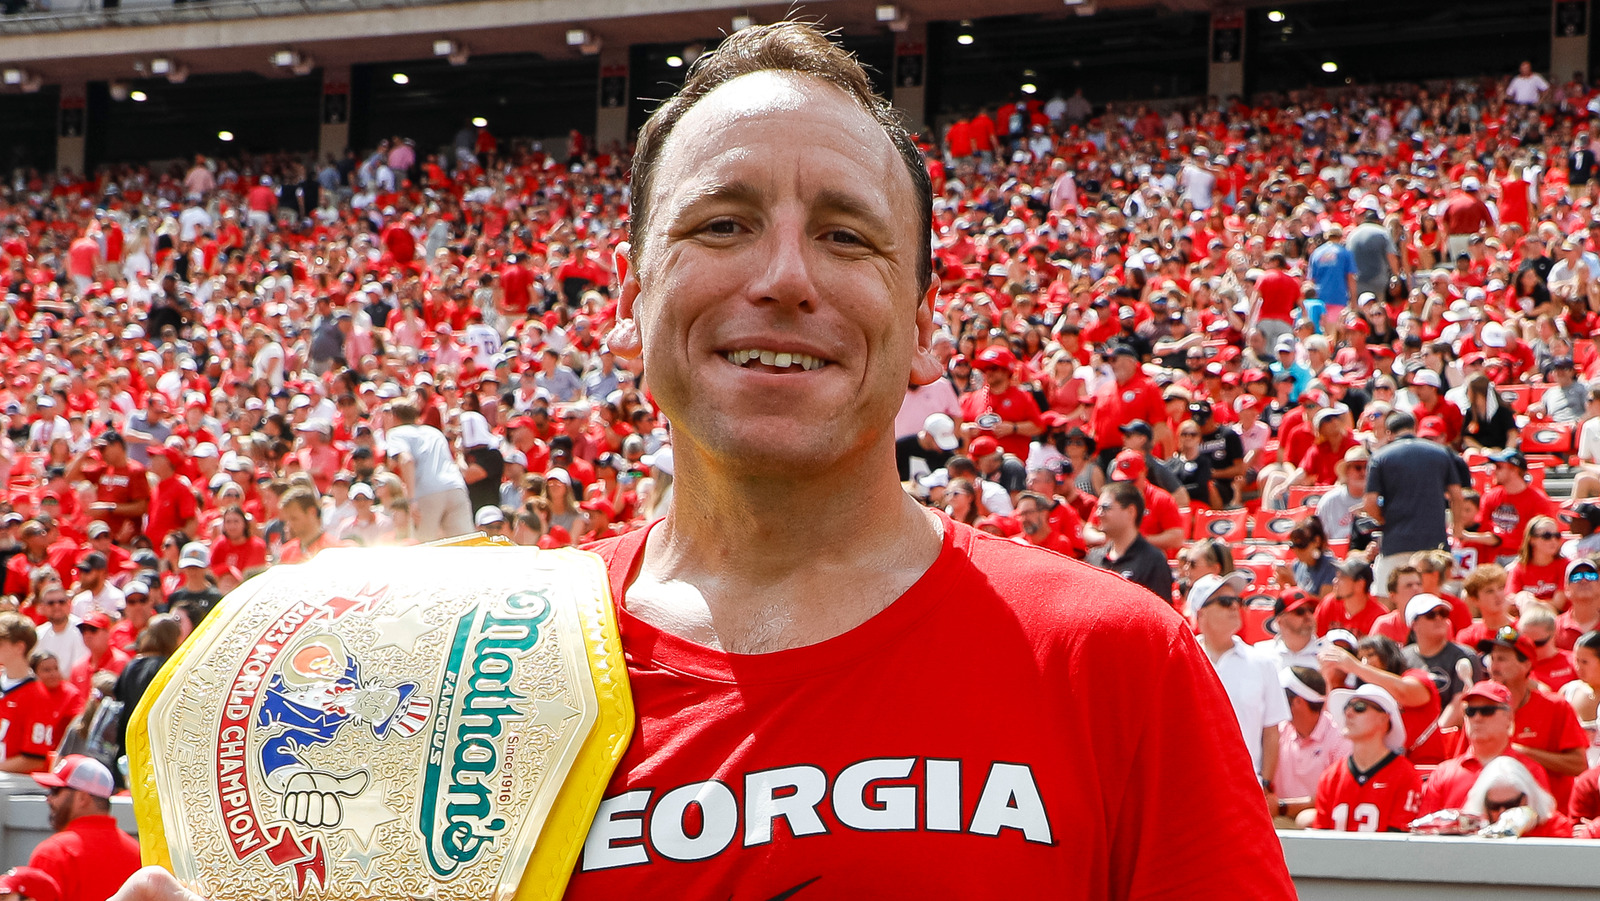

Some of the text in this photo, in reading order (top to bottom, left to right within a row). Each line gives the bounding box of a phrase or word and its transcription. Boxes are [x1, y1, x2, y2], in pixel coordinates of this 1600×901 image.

[220, 601, 316, 853] 2023 WORLD CHAMPION
[430, 670, 458, 766] FAMOUS
[442, 588, 551, 862] Nathan's
[499, 736, 520, 802] Since 1916
[581, 756, 1054, 873] EORGIA
